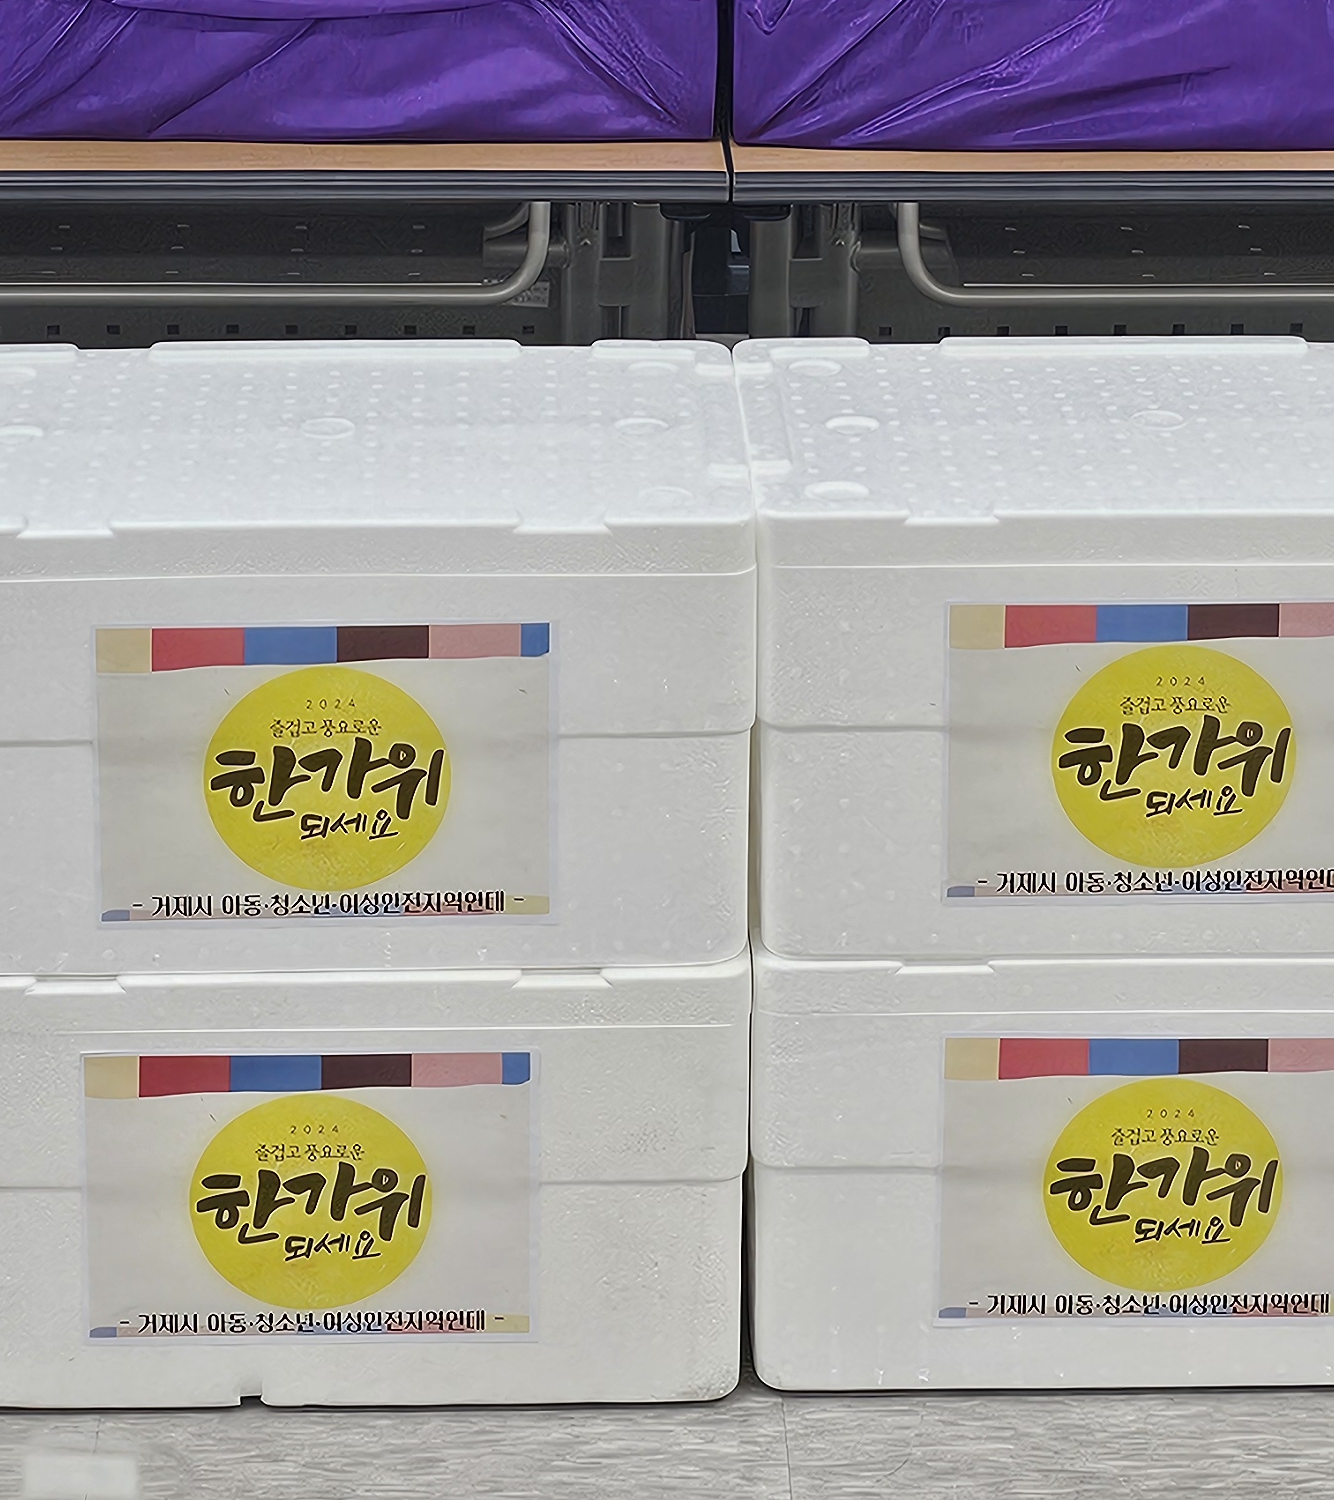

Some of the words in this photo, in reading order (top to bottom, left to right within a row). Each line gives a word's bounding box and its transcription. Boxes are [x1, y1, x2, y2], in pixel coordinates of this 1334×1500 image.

[1156, 677, 1206, 687] 2024
[306, 700, 357, 711] 2024
[1059, 715, 1291, 801] 한가위
[210, 737, 444, 822] 한가위
[1146, 787, 1243, 818] 되세요
[300, 810, 399, 840] 되세요
[996, 871, 1056, 894] 거제시
[151, 894, 213, 918] 거제시
[1146, 1109, 1195, 1119] 2024
[290, 1125, 339, 1135] 2024
[1050, 1146, 1278, 1227] 한가위
[196, 1162, 426, 1245] 한가위
[1135, 1218, 1231, 1244] 되세요
[284, 1230, 381, 1262] 되세요
[986, 1293, 1046, 1315] 거제시
[138, 1313, 199, 1334] 거제시
